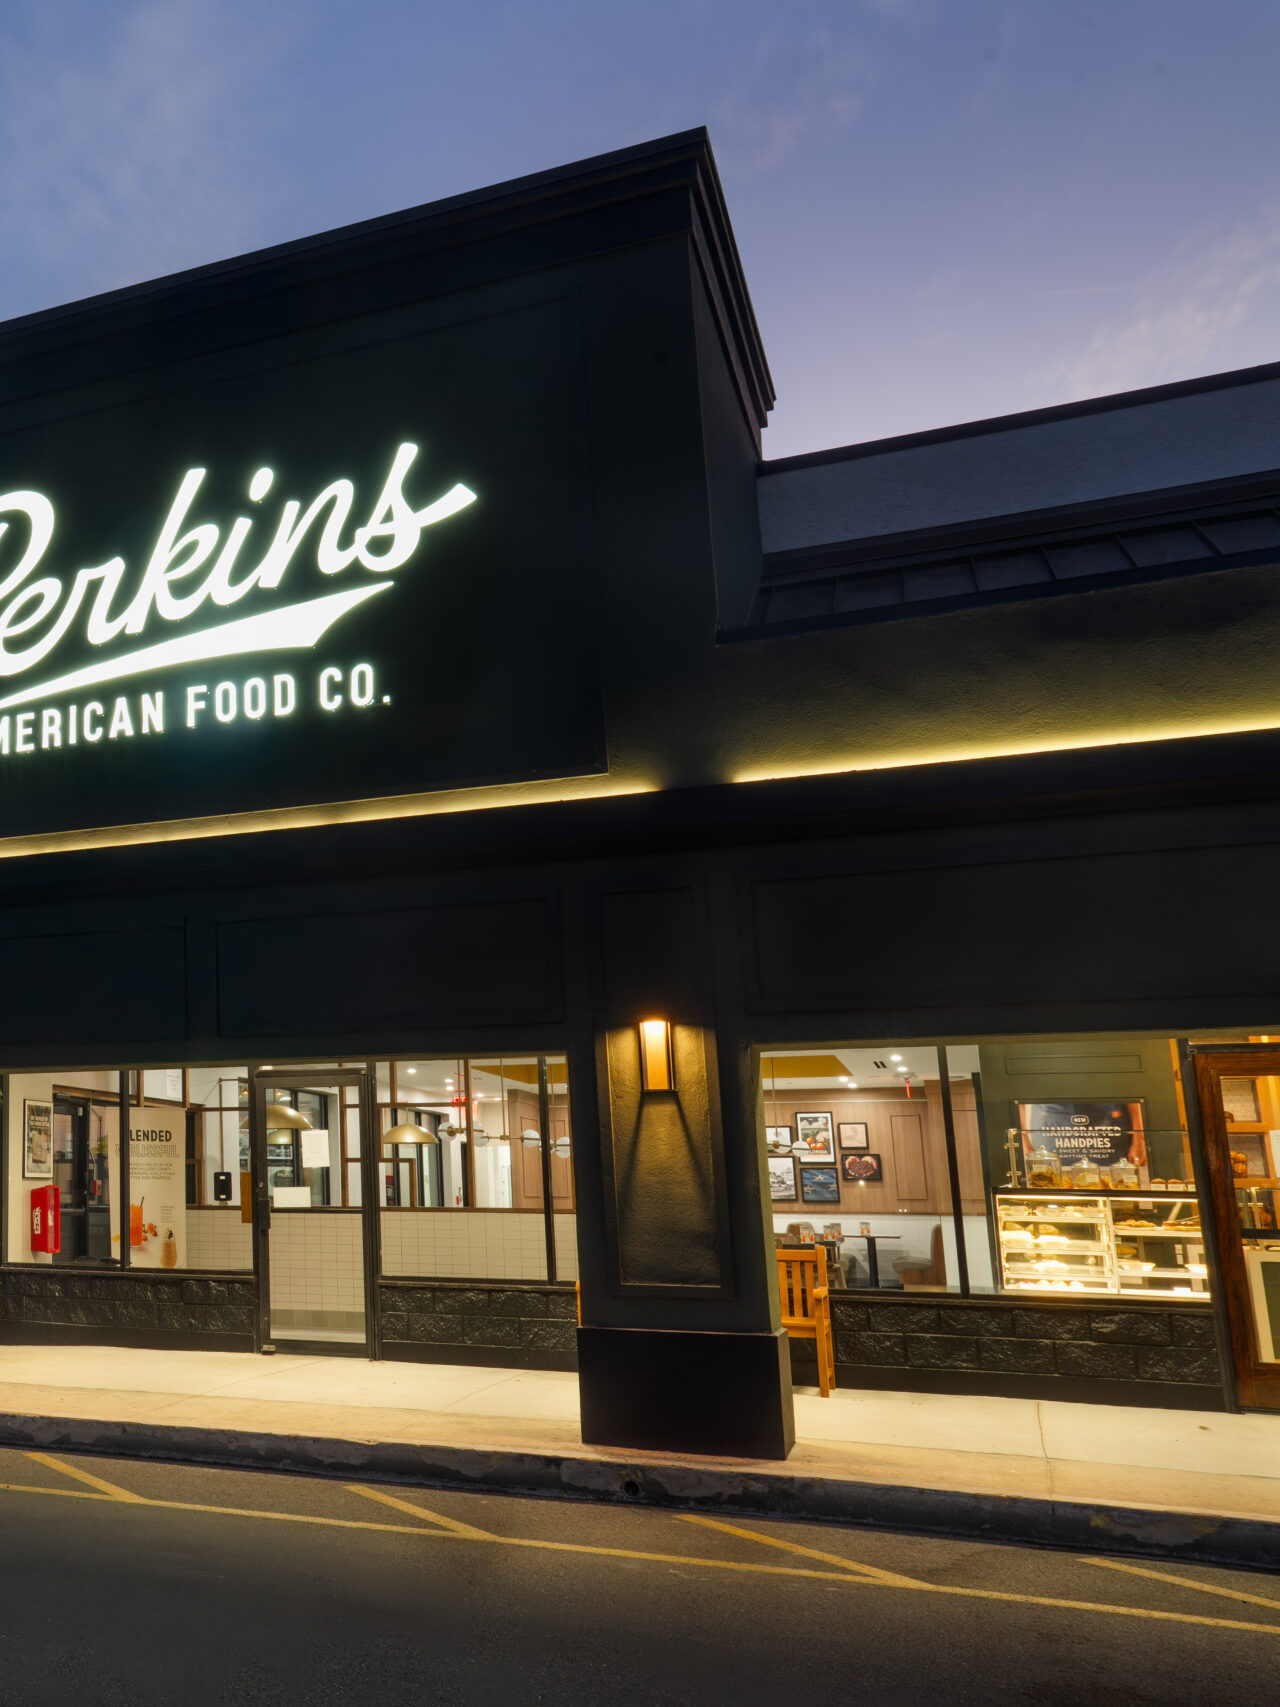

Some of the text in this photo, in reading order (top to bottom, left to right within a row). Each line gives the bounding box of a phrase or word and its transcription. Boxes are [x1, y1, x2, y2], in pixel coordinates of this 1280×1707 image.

[186, 673, 296, 728] FOOD
[319, 663, 391, 711] CO.
[129, 1129, 172, 1142] LENDED
[1055, 1137, 1111, 1148] HANDPIES
